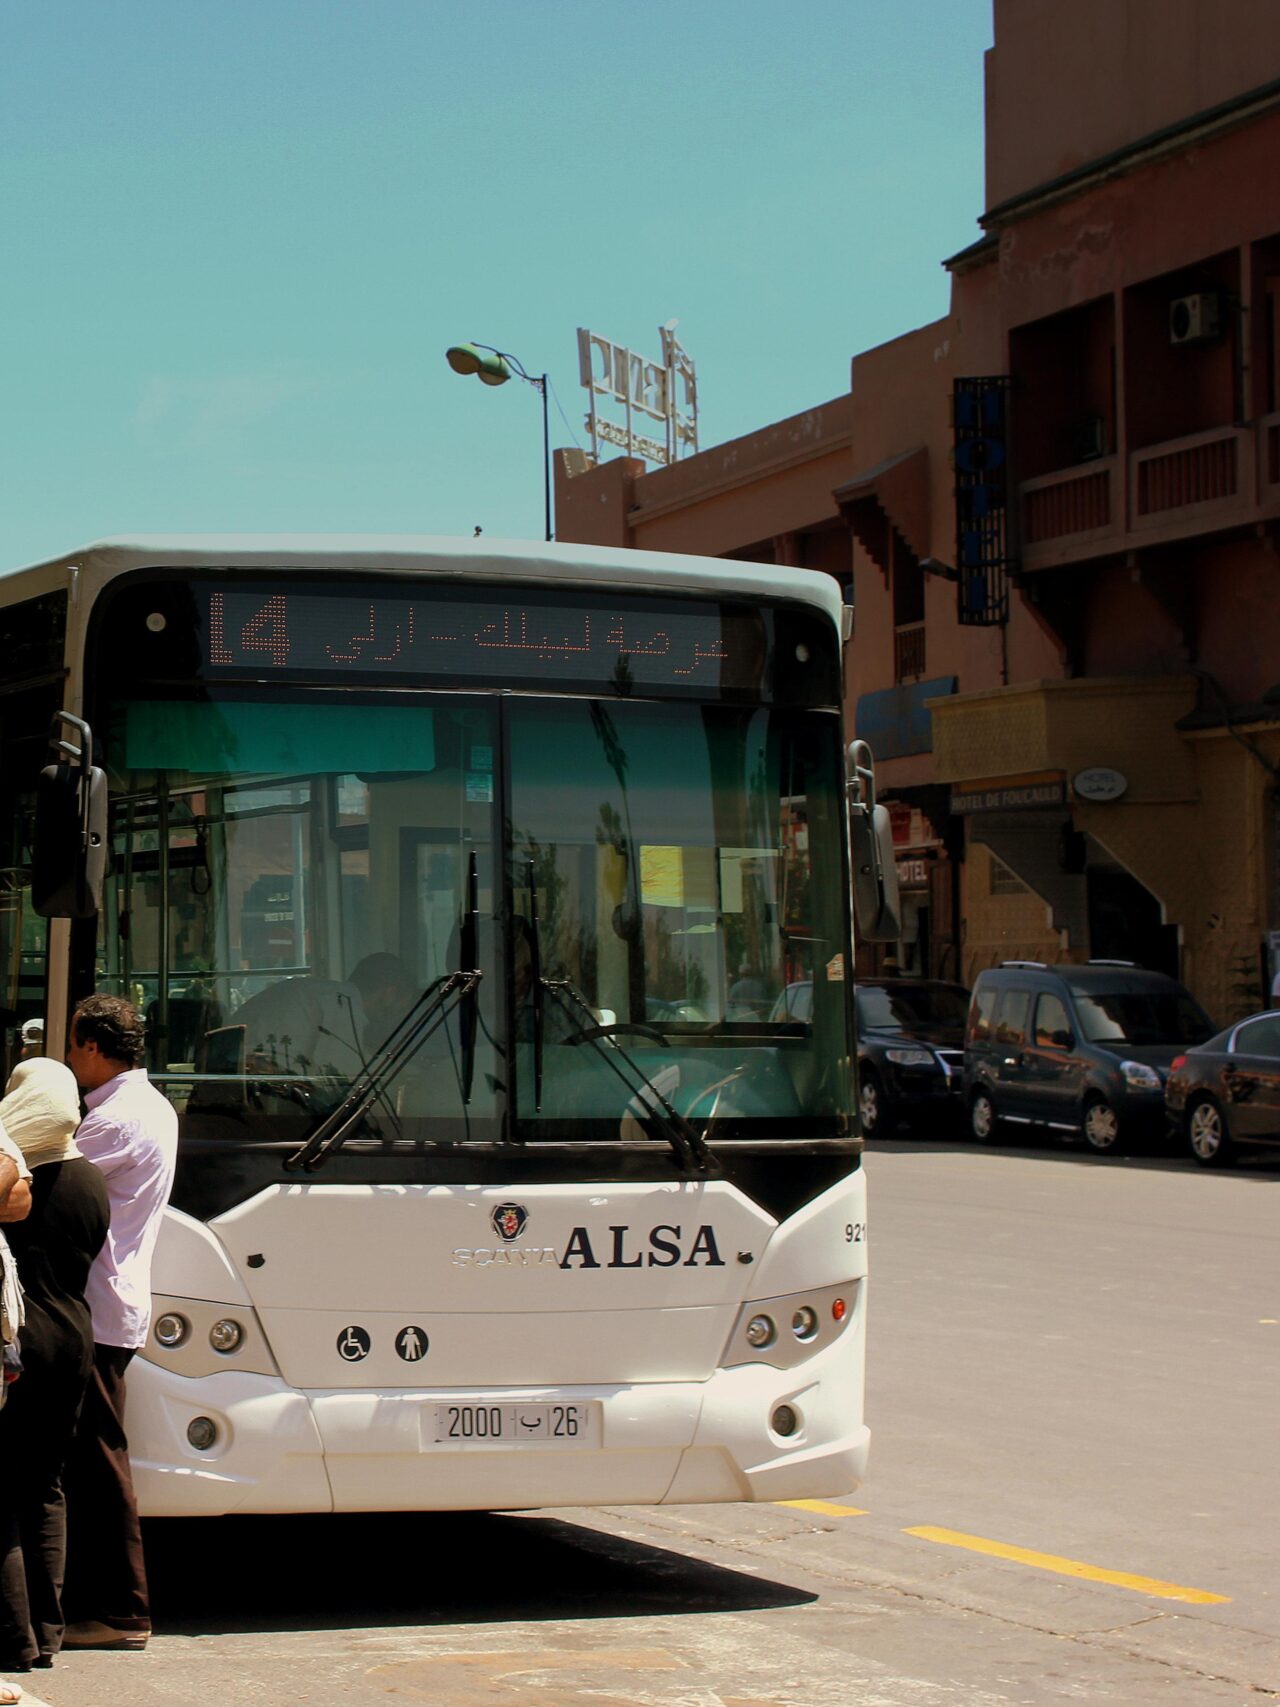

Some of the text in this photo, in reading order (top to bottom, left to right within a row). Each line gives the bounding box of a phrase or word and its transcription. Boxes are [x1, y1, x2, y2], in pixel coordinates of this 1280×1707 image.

[558, 1224, 726, 1270] ALSA
[448, 1406, 578, 1437] 2000 ب 26
